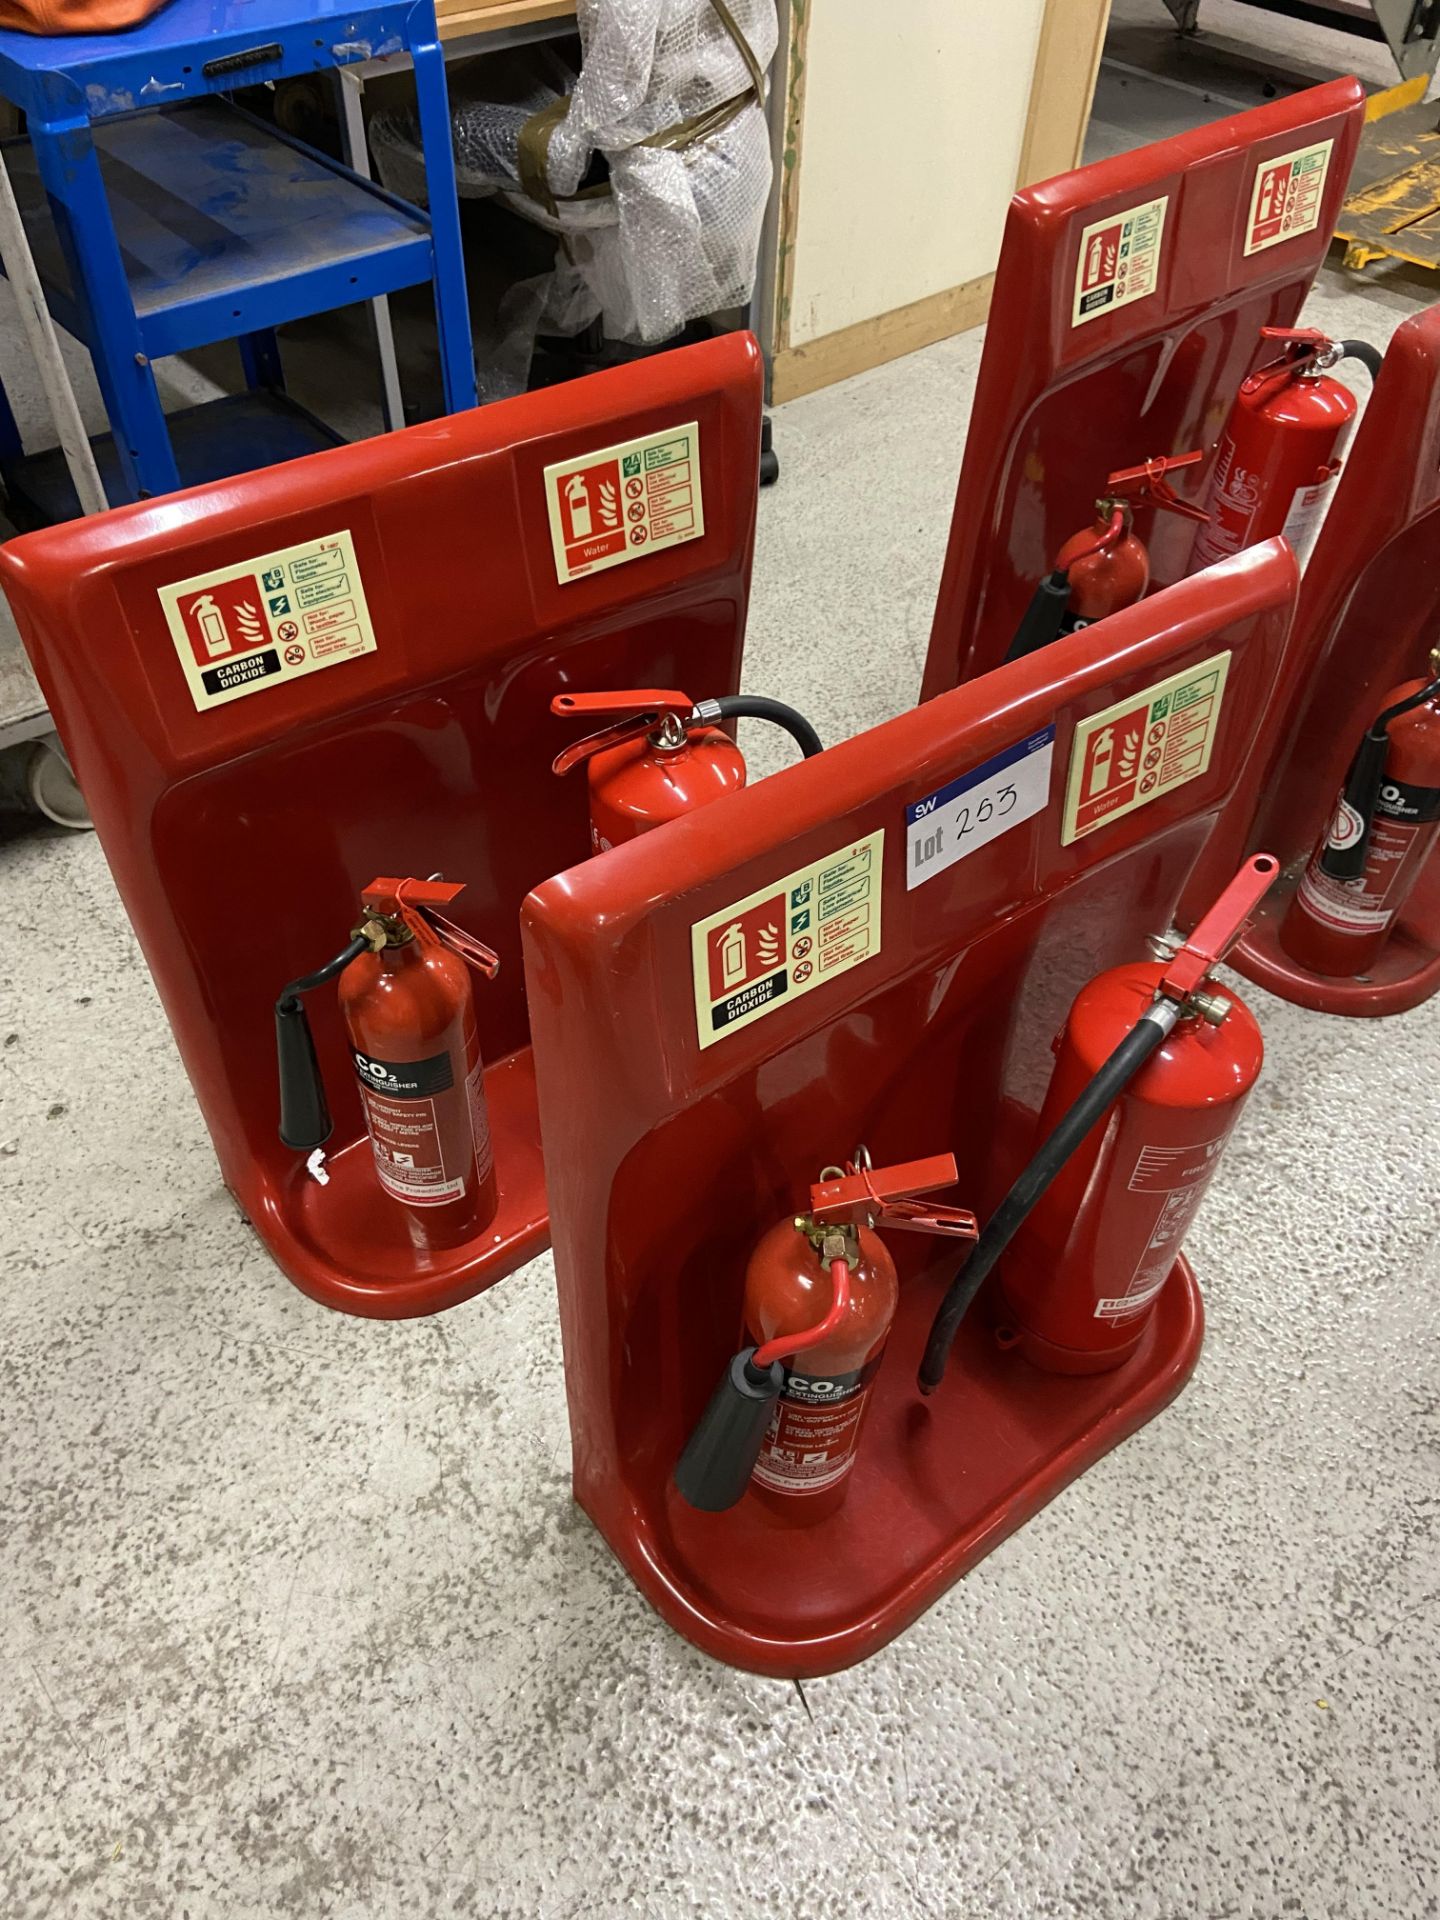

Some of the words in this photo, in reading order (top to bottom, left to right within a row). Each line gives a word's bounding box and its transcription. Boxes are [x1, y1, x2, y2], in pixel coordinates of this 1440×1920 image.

[583, 540, 609, 558] Water
[273, 568, 282, 577] B
[215, 655, 264, 679] CARBON
[219, 664, 267, 688] DIOXIDE
[915, 797, 937, 819] SW
[1092, 794, 1120, 815] Water
[915, 826, 943, 868] Lot
[956, 784, 1017, 840] 253
[803, 881, 810, 892] B
[726, 978, 773, 1011] CARBON
[728, 988, 772, 1020] DIOXIDE
[355, 1053, 398, 1083] CO2
[788, 1377, 844, 1393] CO2
[789, 1383, 861, 1399] EXTINGUISHER
